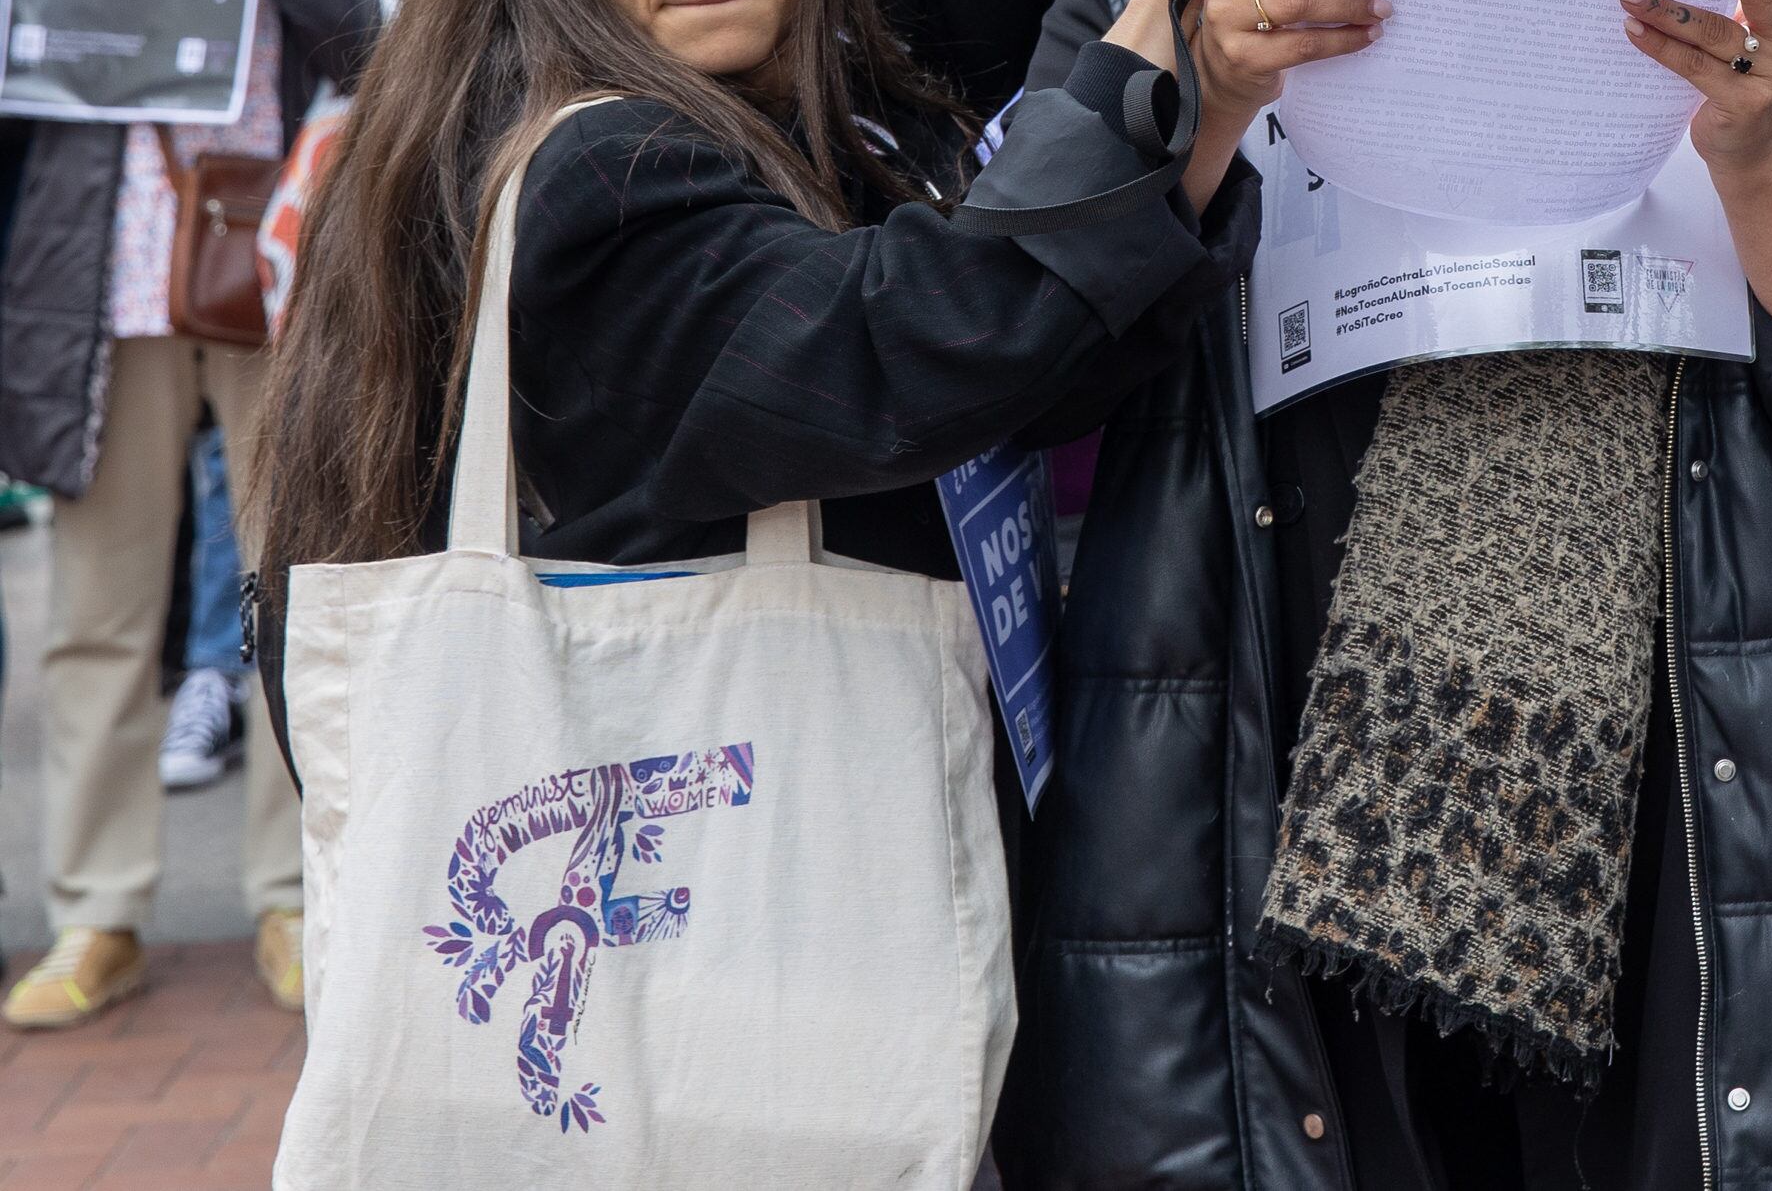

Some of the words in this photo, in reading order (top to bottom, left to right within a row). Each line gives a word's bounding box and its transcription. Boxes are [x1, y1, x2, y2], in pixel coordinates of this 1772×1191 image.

[1334, 255, 1537, 302] #LogroñoContraLaViolenciaSexual
[1335, 274, 1532, 319] #NosTocanAUnaNosTocanATodas
[992, 574, 1029, 647] DE
[646, 785, 732, 816] WOMEN
